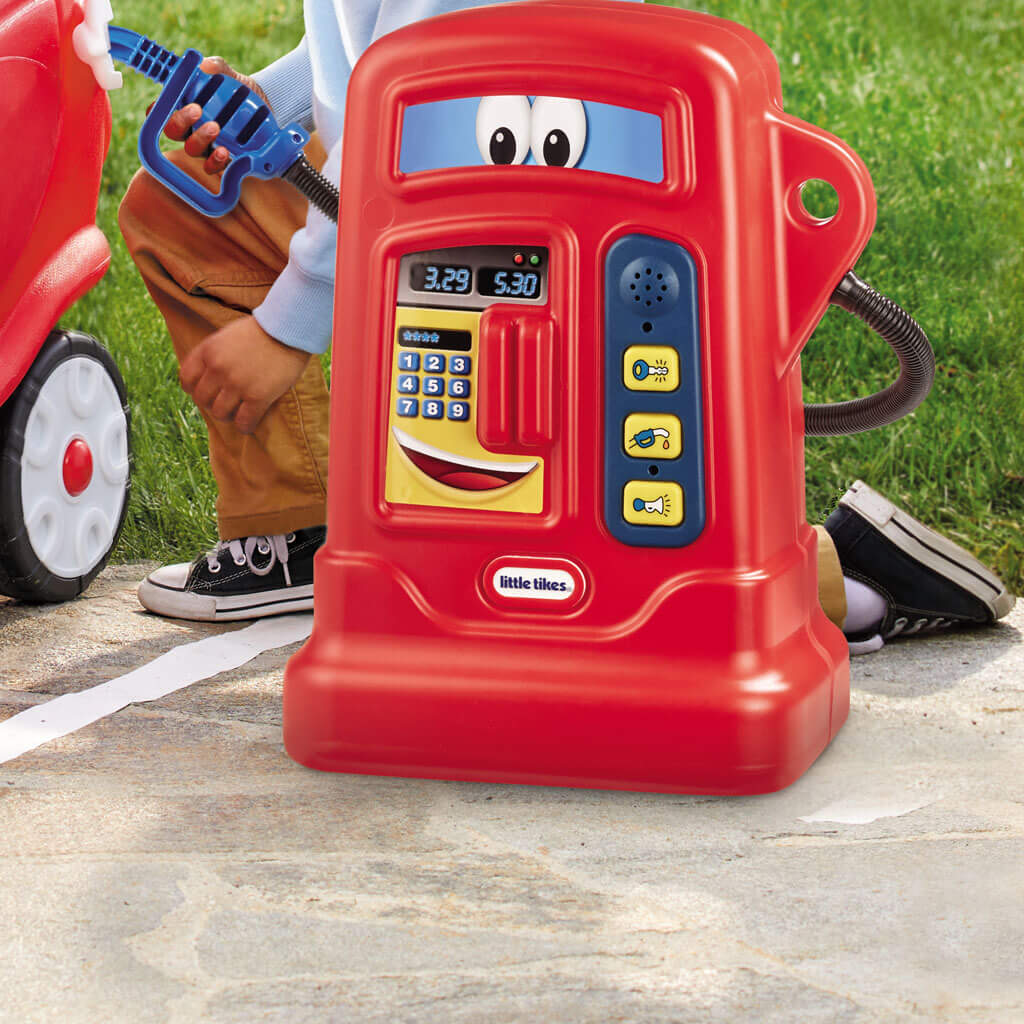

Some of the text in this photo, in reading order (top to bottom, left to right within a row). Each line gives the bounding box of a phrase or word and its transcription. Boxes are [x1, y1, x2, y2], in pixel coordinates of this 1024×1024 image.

[424, 266, 470, 291] 3.29
[494, 271, 538, 296] 5.30
[404, 354, 465, 371] 1 2 3
[402, 377, 464, 394] 4 5 6
[402, 400, 464, 417] 7 8 9
[500, 575, 567, 592] little tikes
